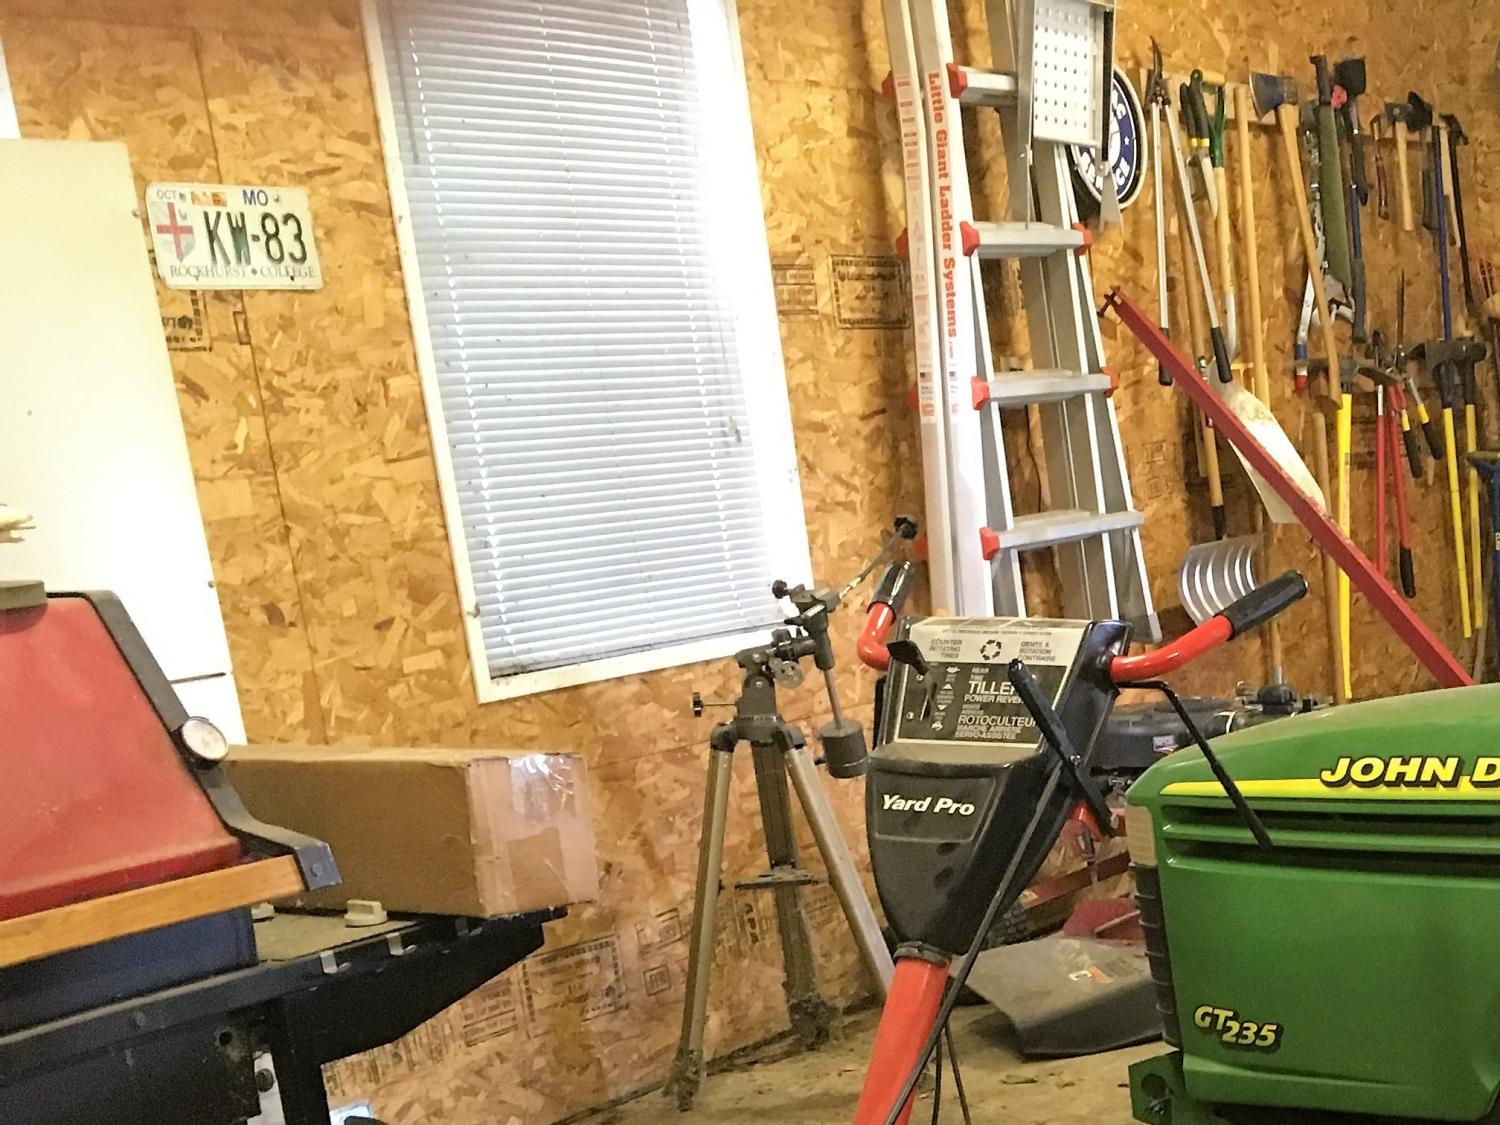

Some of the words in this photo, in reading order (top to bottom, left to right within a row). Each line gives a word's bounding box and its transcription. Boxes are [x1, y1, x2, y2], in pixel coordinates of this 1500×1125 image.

[929, 72, 944, 123] Little
[936, 129, 948, 179] Giant
[156, 189, 177, 200] OCT
[242, 189, 269, 206] MO
[940, 185, 952, 250] Ladder
[203, 210, 307, 265] KW-83
[170, 264, 247, 280] ROCKHURST
[260, 265, 315, 279] COLLEGE
[943, 257, 956, 337] Systems
[968, 680, 1015, 695] TILLE
[1320, 756, 1462, 787] JOHN
[882, 794, 932, 812] Yard
[933, 797, 975, 816] Pro
